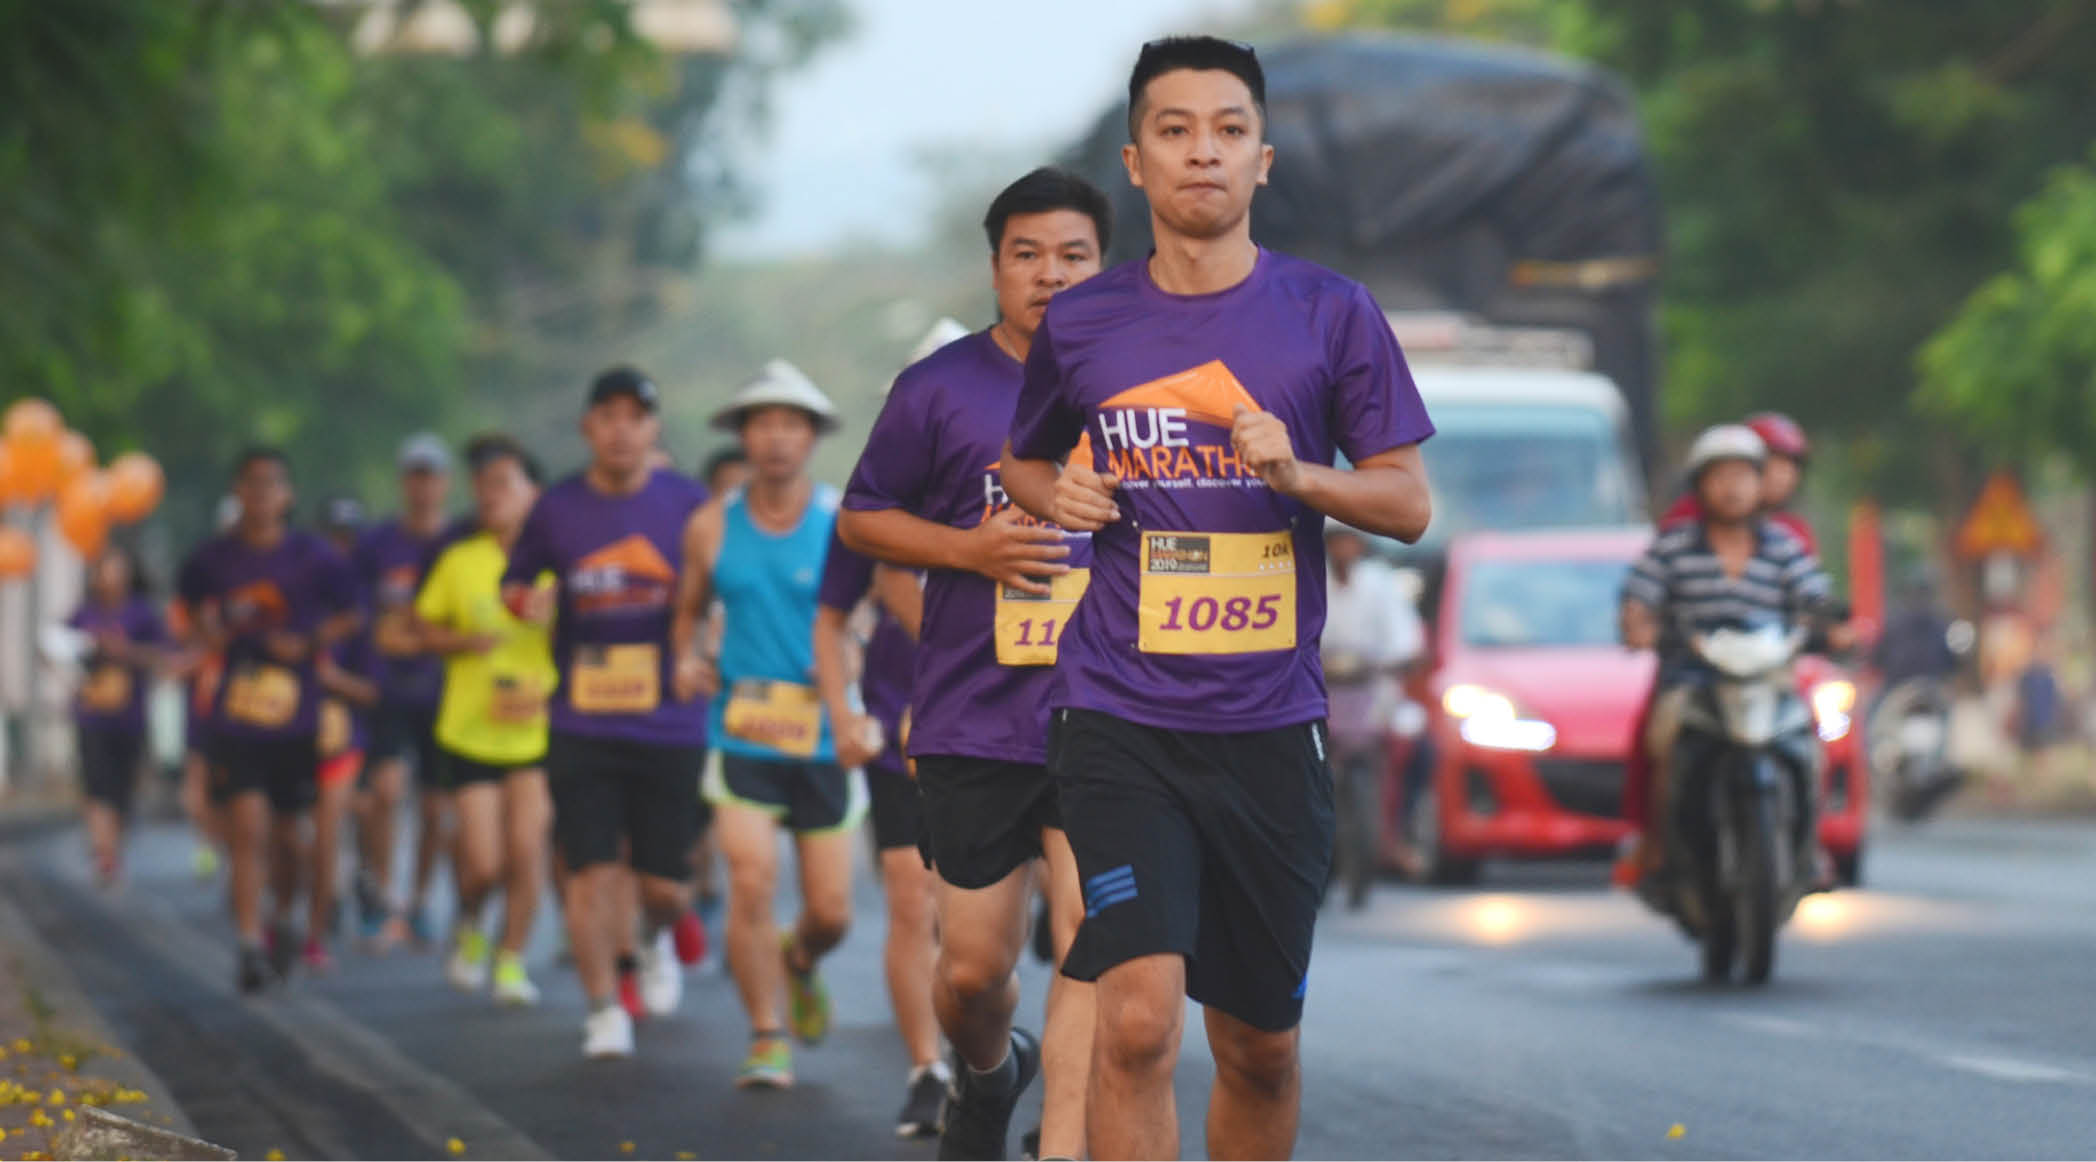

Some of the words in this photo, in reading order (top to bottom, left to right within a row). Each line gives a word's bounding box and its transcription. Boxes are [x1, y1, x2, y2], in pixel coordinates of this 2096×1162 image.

[1099, 408, 1189, 450] HUE
[1108, 445, 1258, 480] MARATH
[1151, 536, 1177, 551] HUE
[1159, 593, 1282, 632] 1085
[1014, 618, 1057, 646] 11
